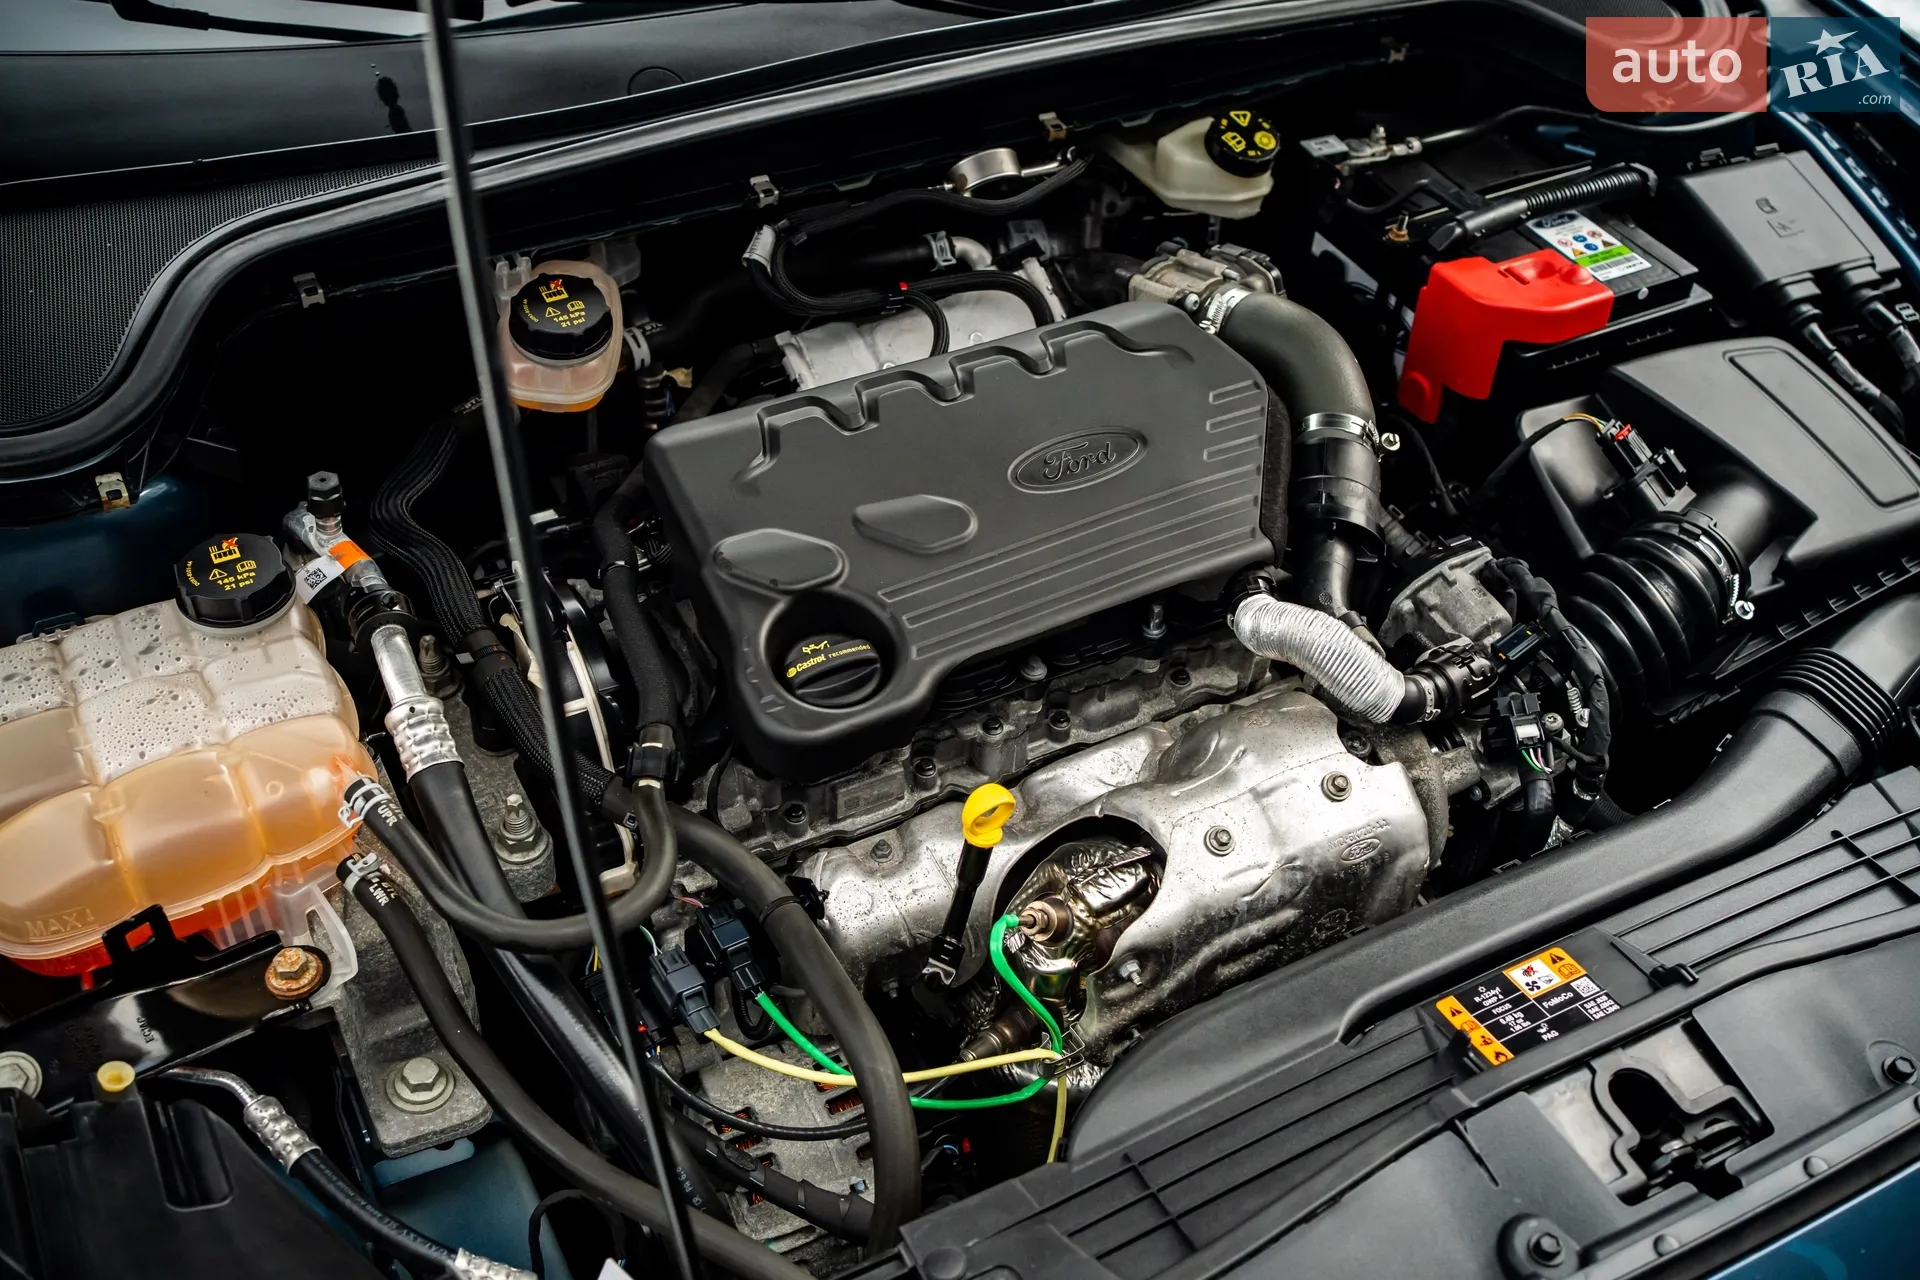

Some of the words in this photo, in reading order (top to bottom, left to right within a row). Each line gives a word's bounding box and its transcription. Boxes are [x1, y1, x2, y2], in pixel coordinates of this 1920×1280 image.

[553, 314, 569, 323] 145
[570, 310, 586, 318] kPa
[573, 317, 586, 326] psi
[1043, 441, 1117, 481] Ford
[216, 576, 235, 586] 145
[237, 571, 256, 581] kPa
[224, 583, 236, 591] 21
[239, 579, 254, 588] psi
[796, 654, 827, 672] Castrol
[377, 805, 398, 827] UPR
[368, 883, 390, 907] LWR
[1474, 986, 1502, 1003] R-1234yf
[1542, 991, 1574, 1009] FoMoCo
[1482, 997, 1498, 1007] GWP
[1584, 999, 1596, 1009] SAE
[1492, 1003, 1513, 1015] FOCUS
[1588, 1006, 1600, 1015] SAE
[1592, 1010, 1605, 1020] SAE
[1514, 1011, 1525, 1021] kg
[1541, 1030, 1559, 1042] PAG
